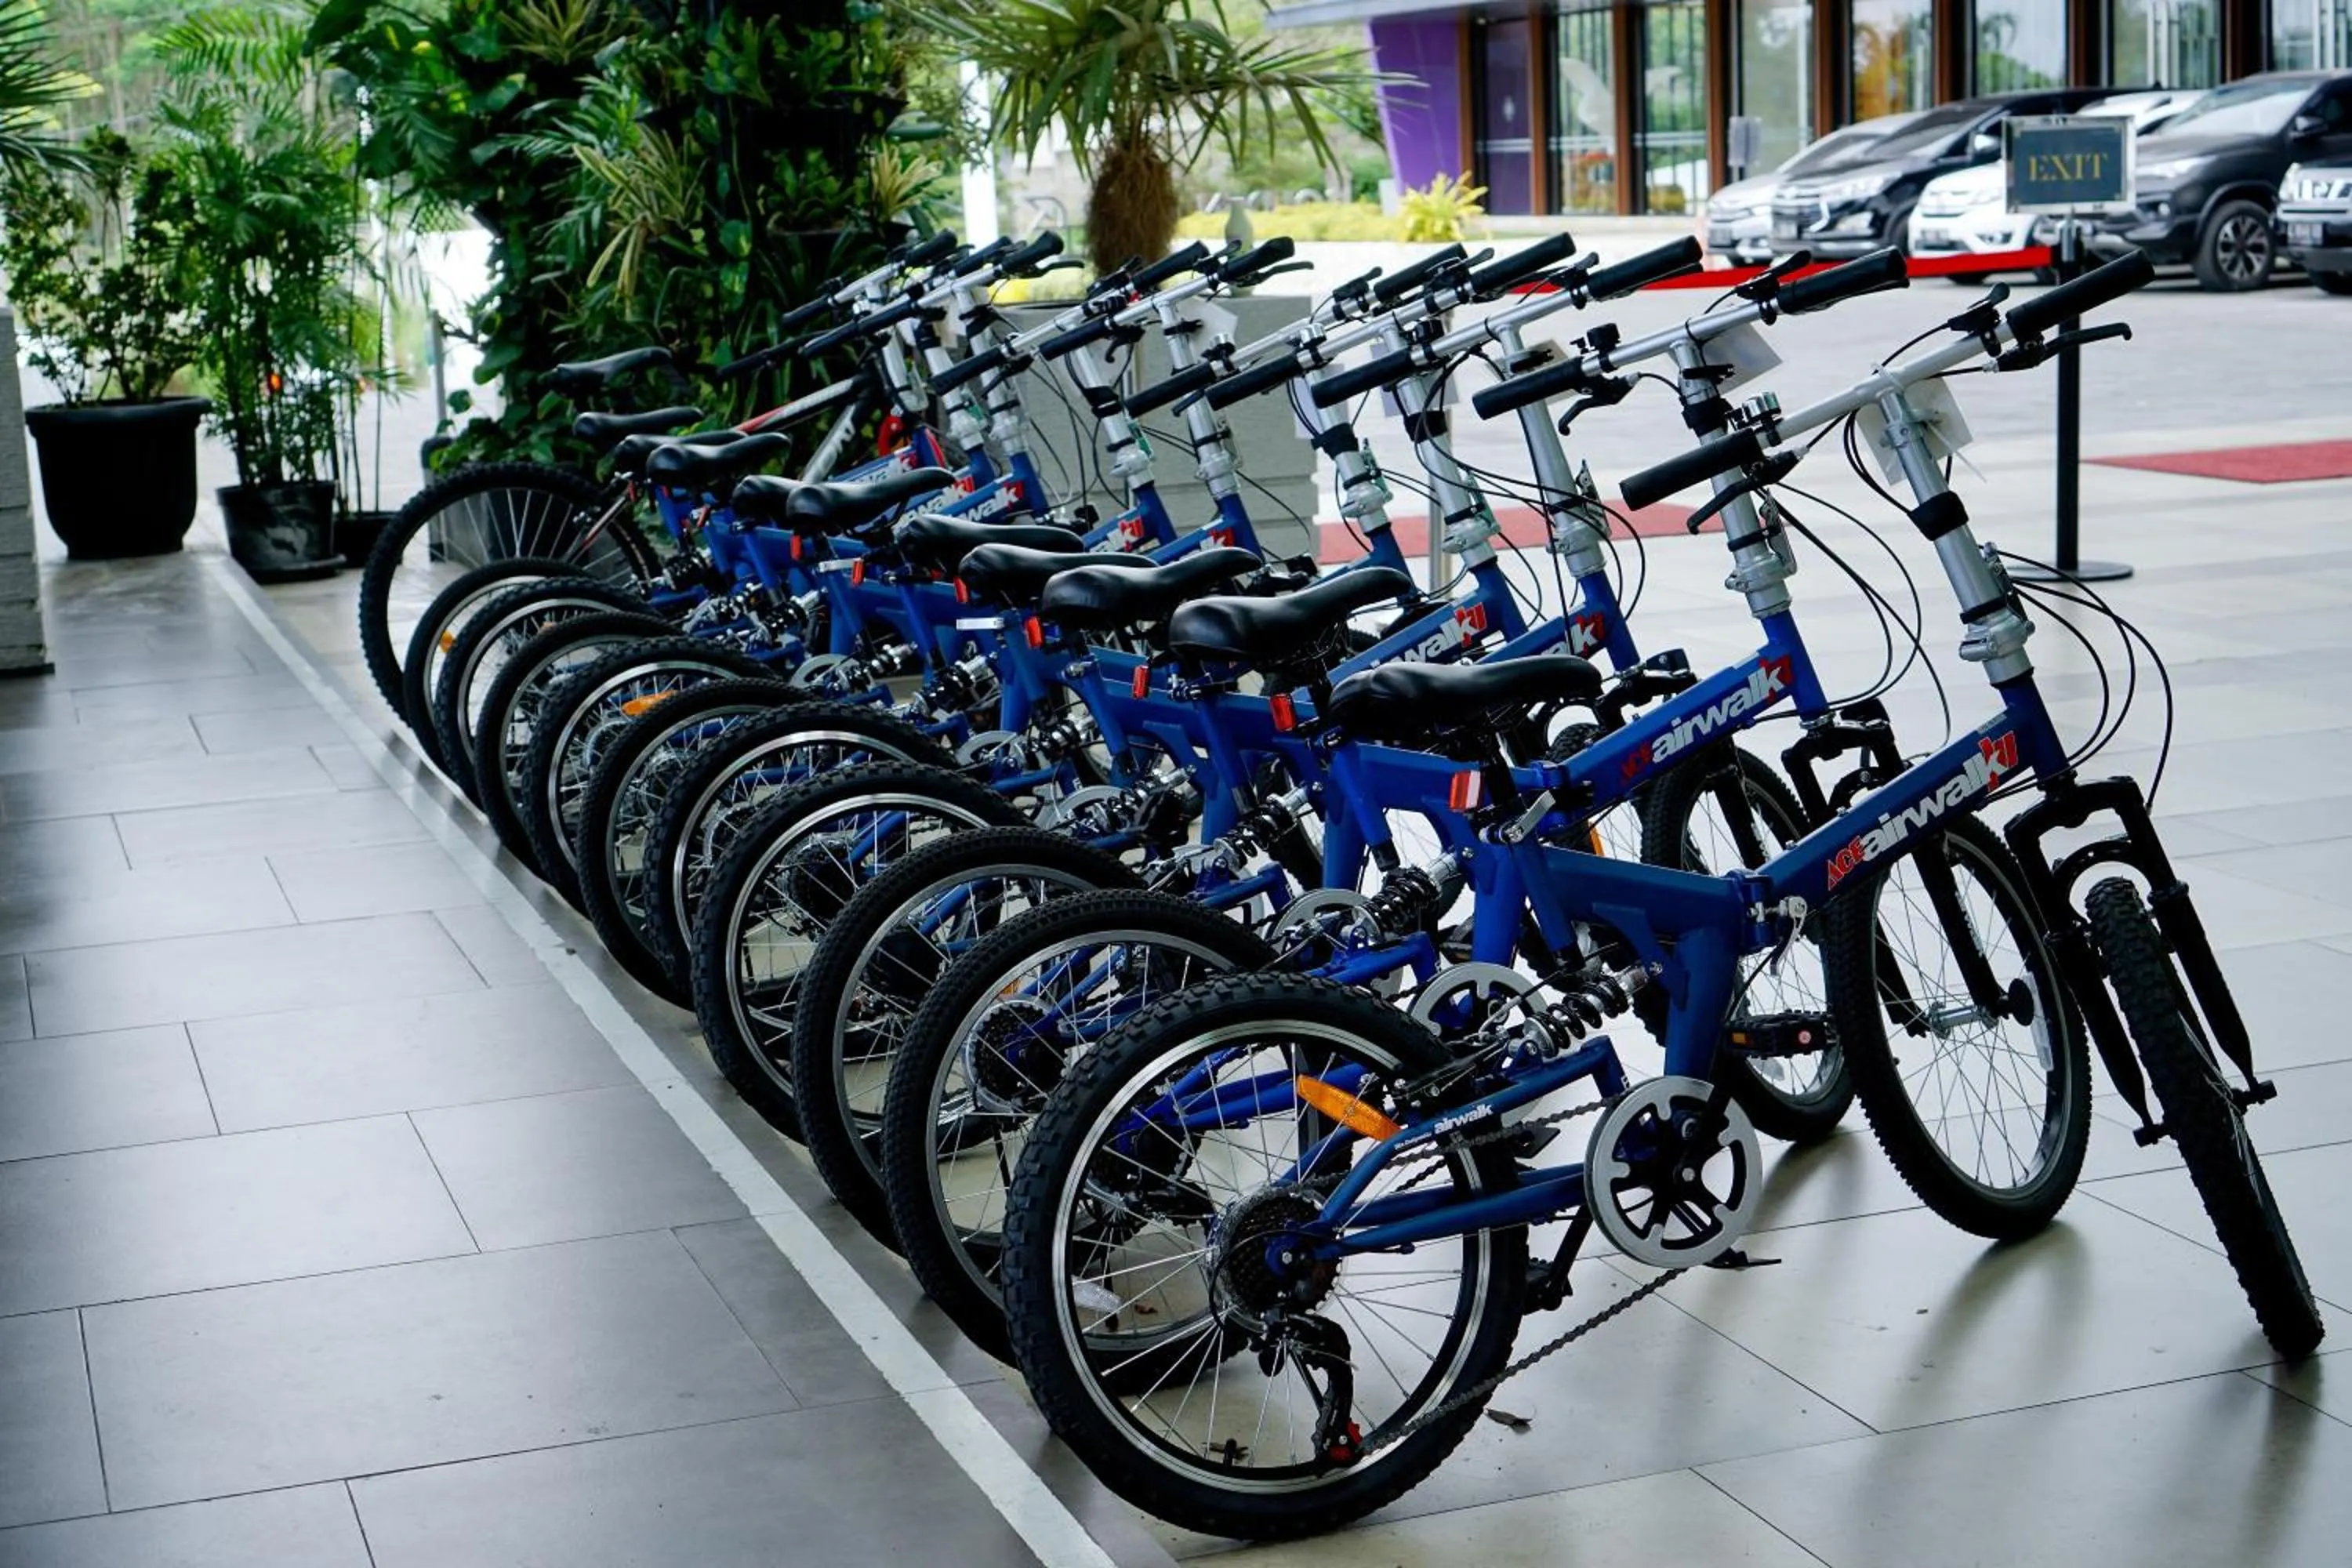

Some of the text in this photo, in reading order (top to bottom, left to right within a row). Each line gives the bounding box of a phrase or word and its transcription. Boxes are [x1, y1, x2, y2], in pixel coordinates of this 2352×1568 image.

[2029, 152, 2109, 182] EXIT
[1651, 666, 1786, 764] airwalk
[1860, 751, 2009, 862] airwalk
[1434, 1104, 1493, 1134] airwalk
